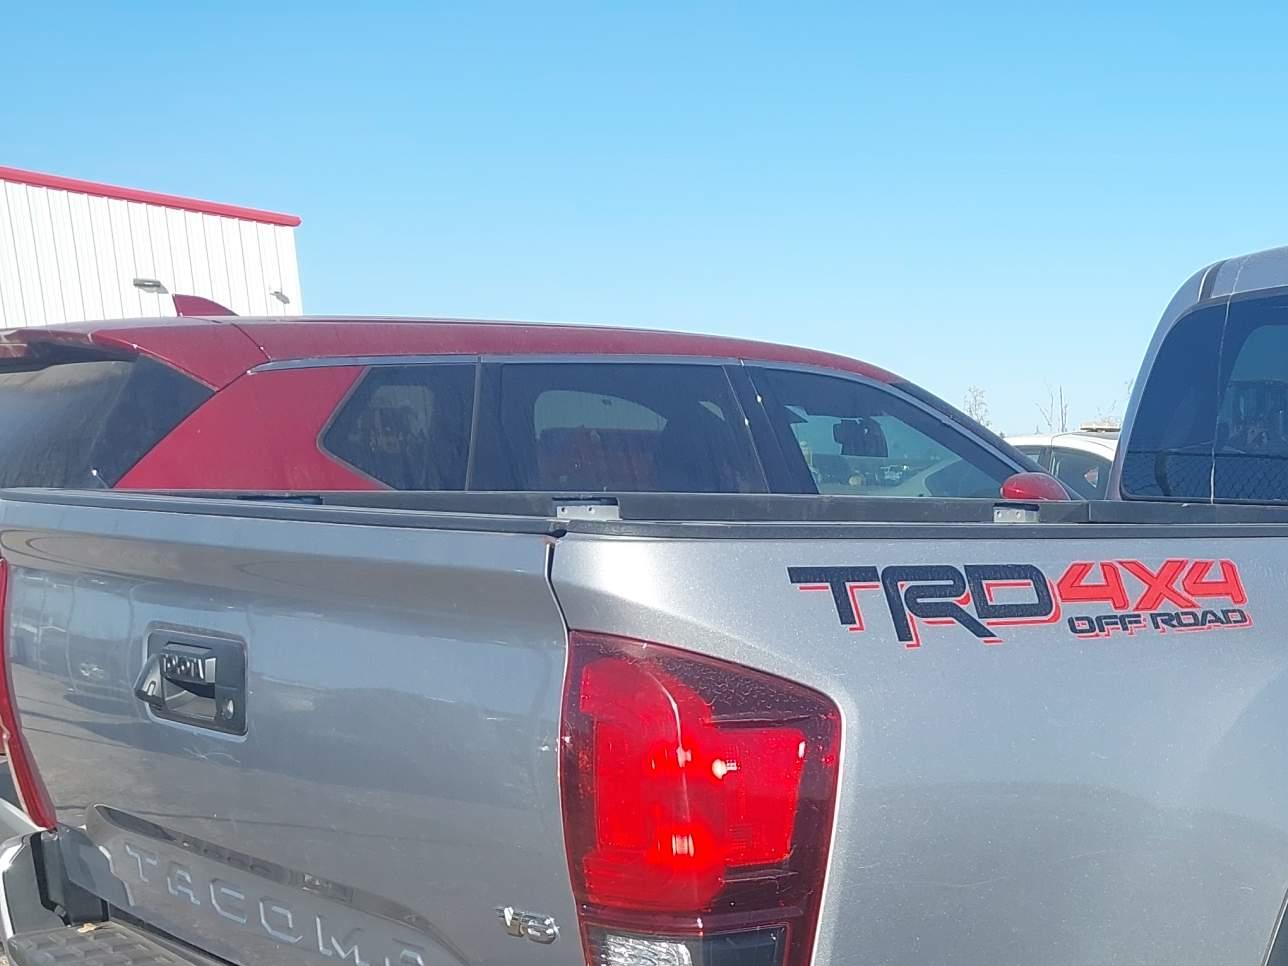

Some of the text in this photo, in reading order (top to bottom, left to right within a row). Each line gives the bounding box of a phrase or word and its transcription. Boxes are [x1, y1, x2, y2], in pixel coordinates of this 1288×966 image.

[786, 558, 1249, 648] TRD 4X4
[1067, 608, 1254, 638] OFF ROAD
